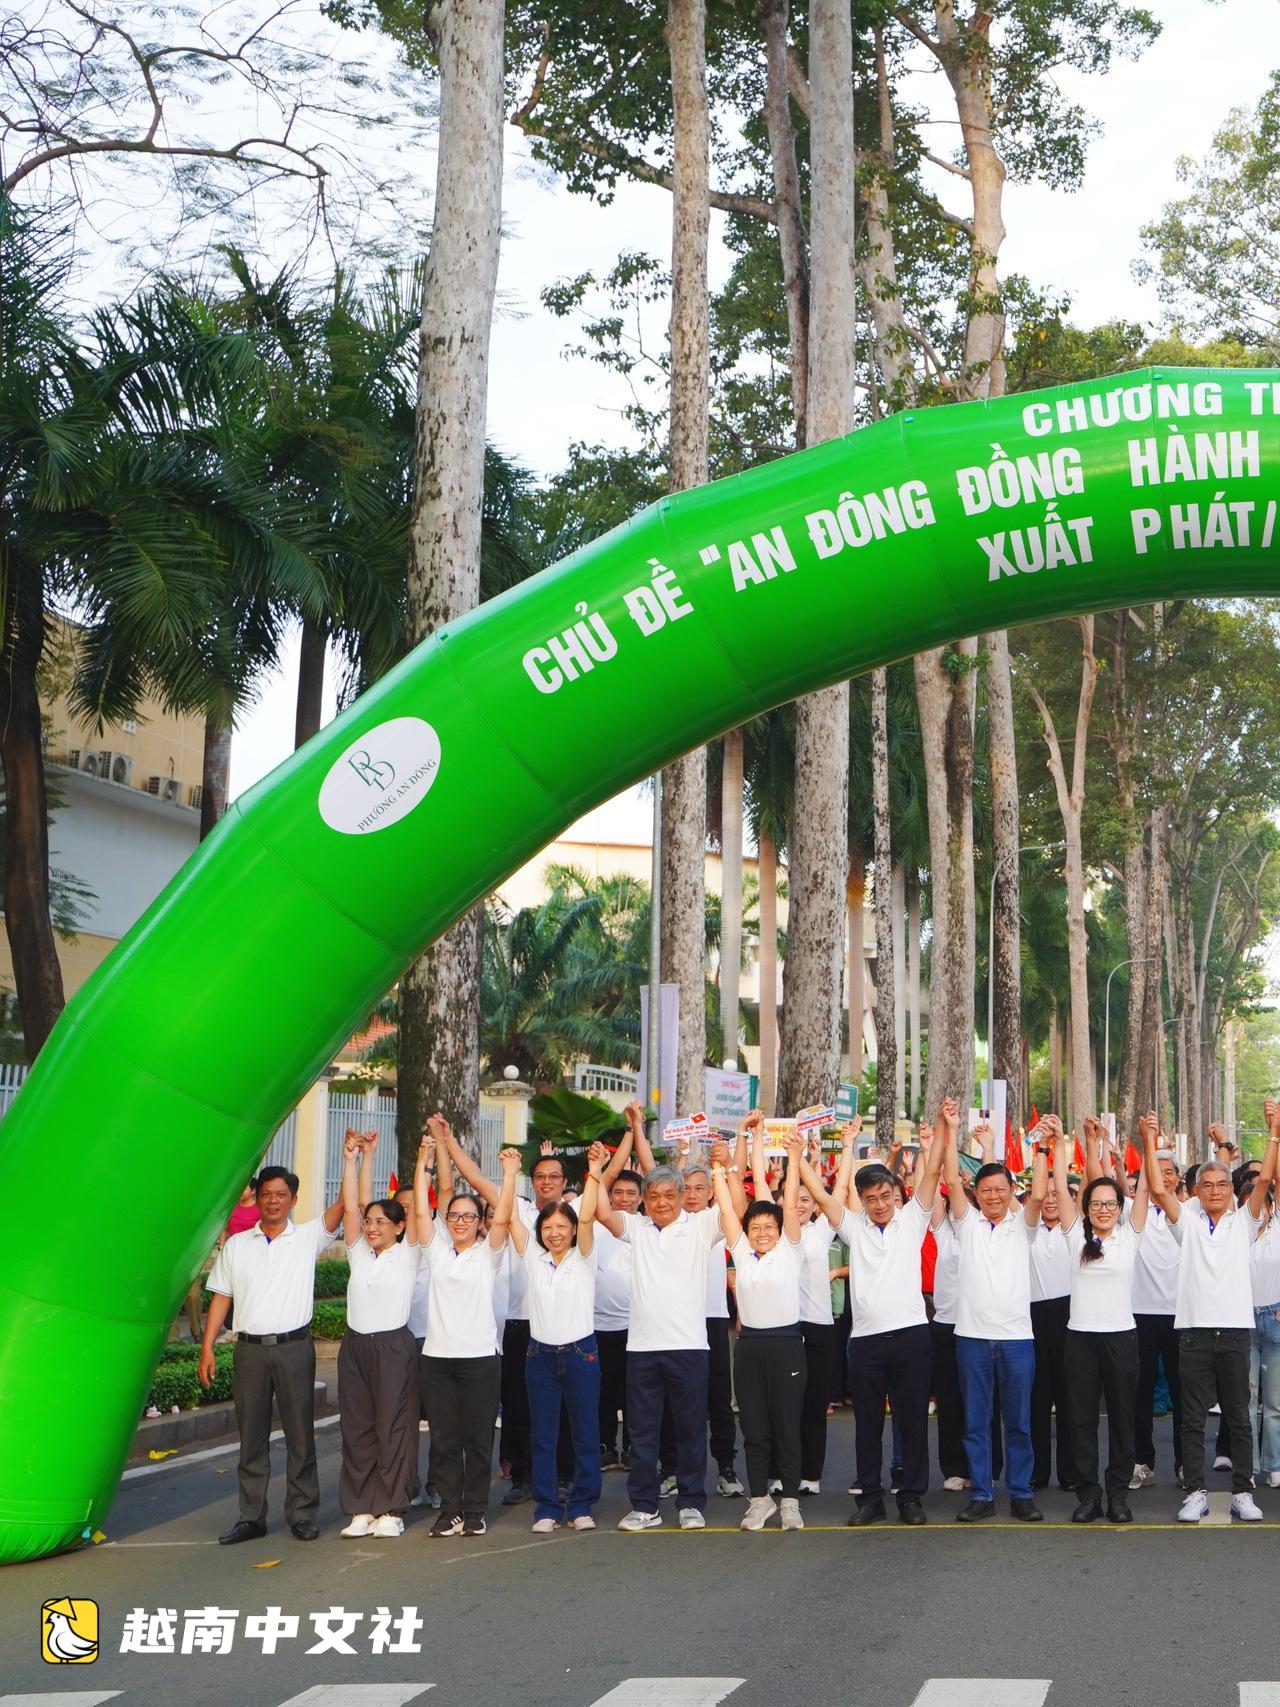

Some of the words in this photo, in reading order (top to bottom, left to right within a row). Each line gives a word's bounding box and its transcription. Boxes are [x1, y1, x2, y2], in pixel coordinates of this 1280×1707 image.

[1022, 382, 1223, 437] CHƯƠNG
[522, 602, 618, 694] CHỦ
[623, 558, 694, 637] ĐỀ
[806, 480, 936, 560] ĐÔNG
[957, 443, 1084, 516] ĐỒNG
[1128, 425, 1260, 487] HÀNH
[978, 502, 1093, 582] XUẤT
[358, 794, 397, 831] PHƯỜNG
[396, 783, 411, 798] AN
